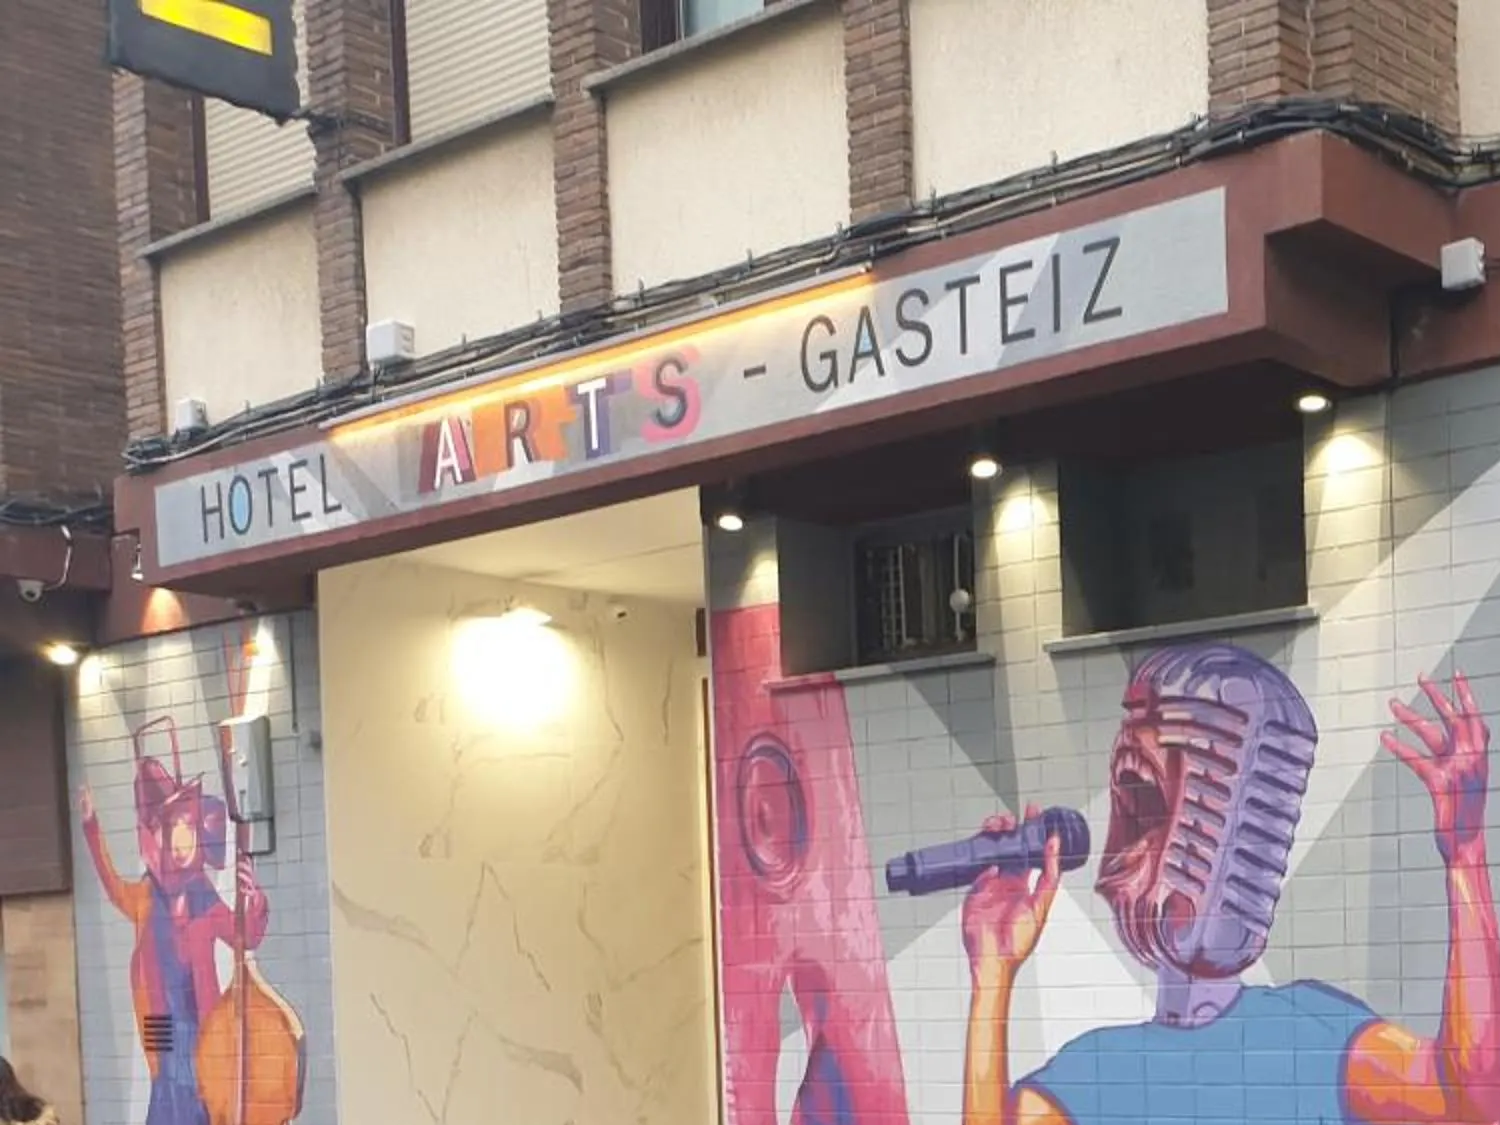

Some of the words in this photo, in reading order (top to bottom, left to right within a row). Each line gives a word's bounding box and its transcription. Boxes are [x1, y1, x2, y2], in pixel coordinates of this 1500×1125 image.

[200, 454, 342, 543] HOTEL
[425, 348, 698, 491] ARTS
[800, 237, 1123, 393] GASTEIZ
